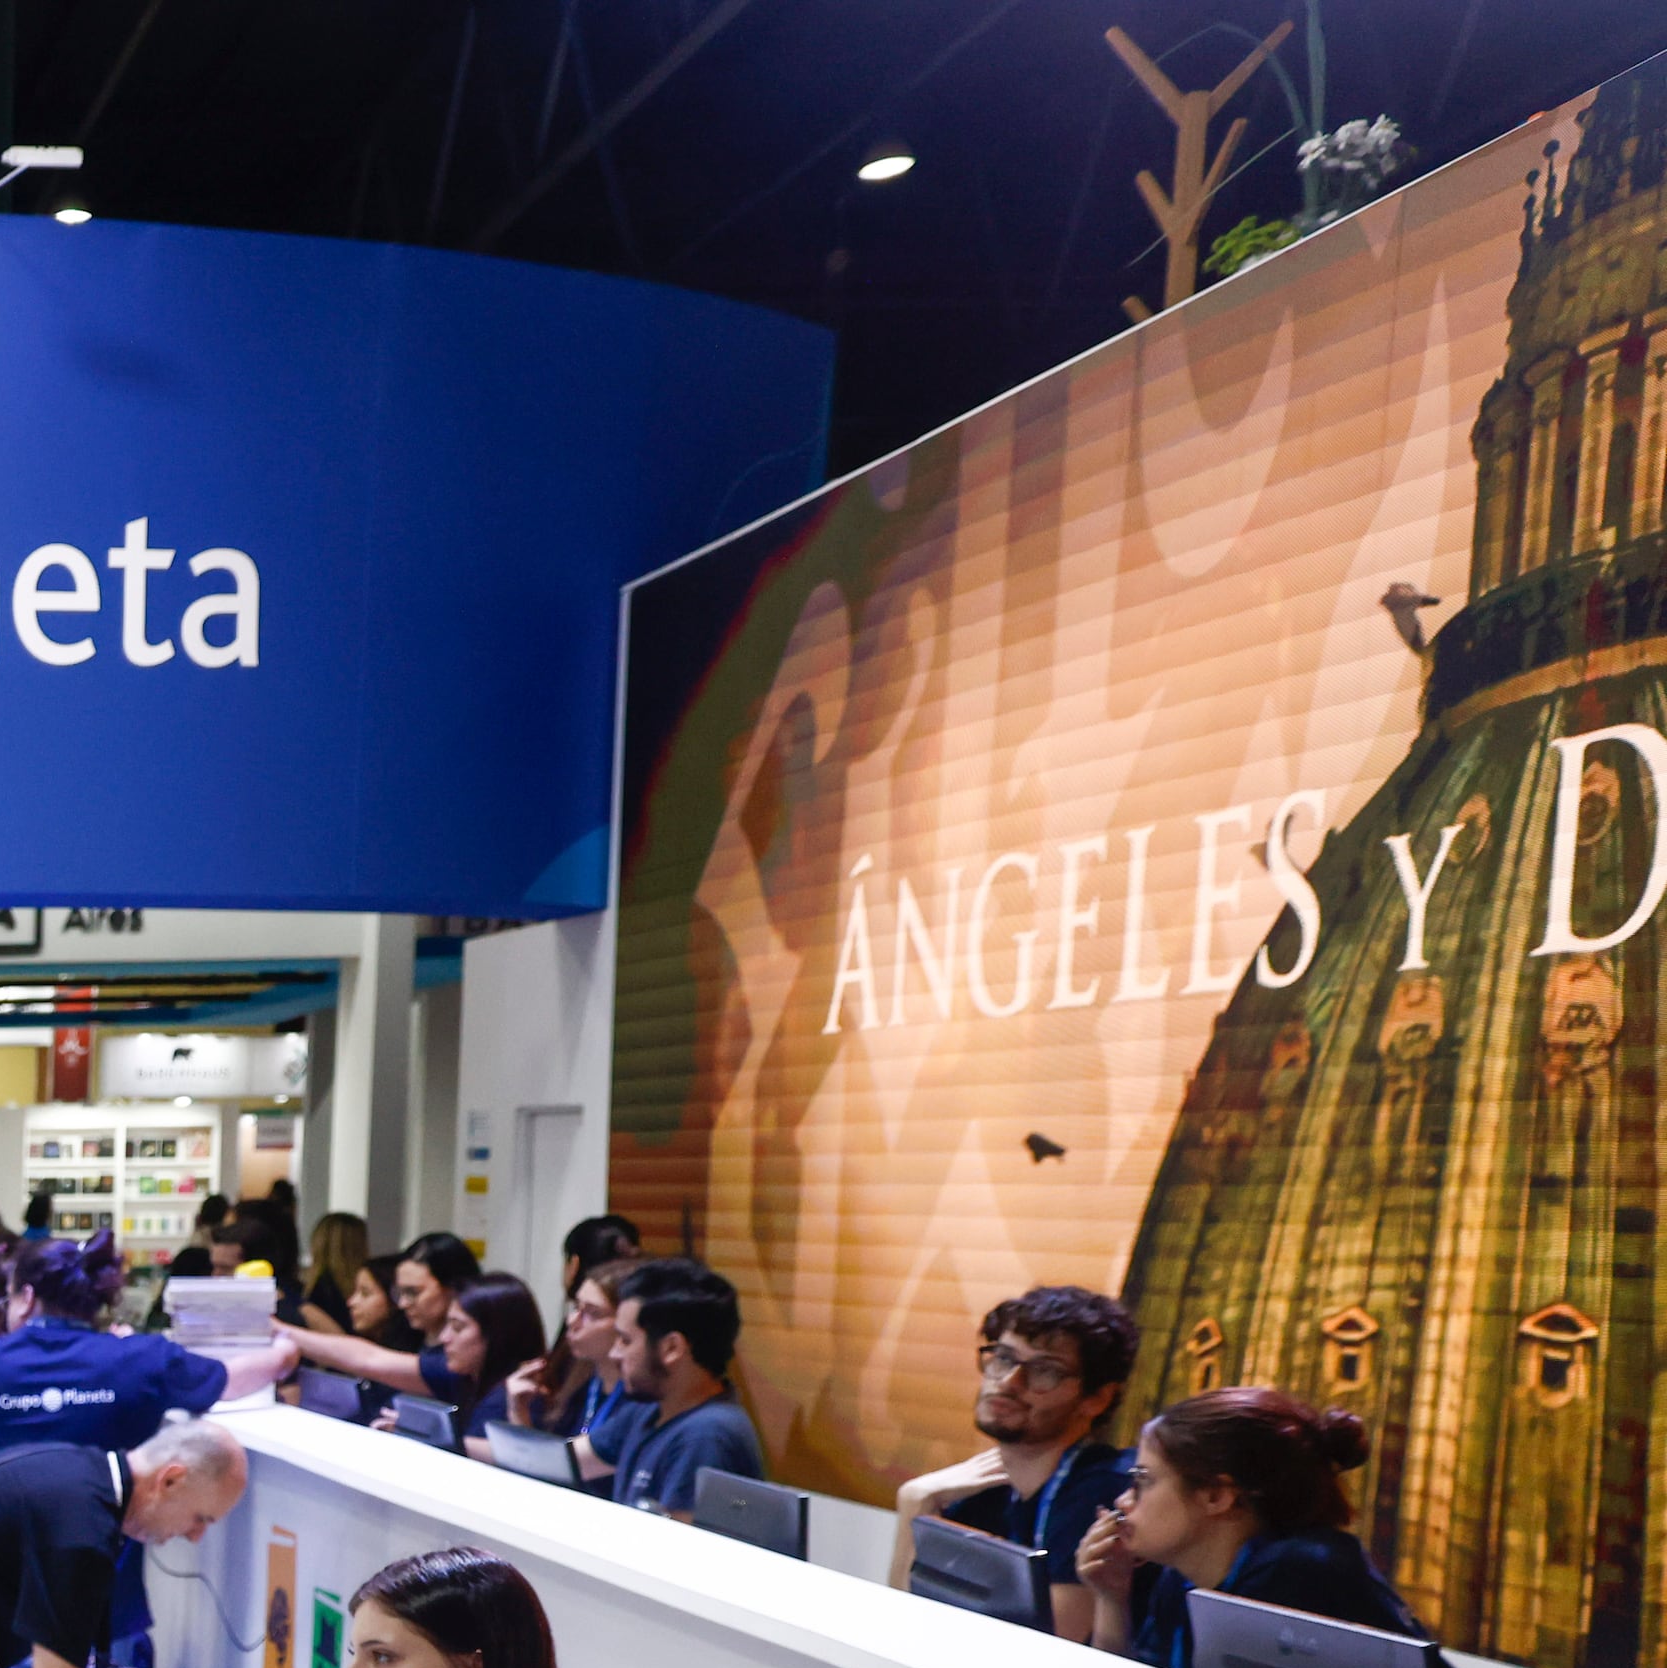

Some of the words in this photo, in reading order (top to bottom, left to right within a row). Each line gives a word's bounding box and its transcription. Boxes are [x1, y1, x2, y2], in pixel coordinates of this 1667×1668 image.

[822, 788, 1327, 1036] ÁNGELES
[1383, 823, 1464, 972] Y
[1531, 722, 1667, 957] D
[0, 1393, 42, 1411] Grupo
[63, 1388, 115, 1405] Planeta
